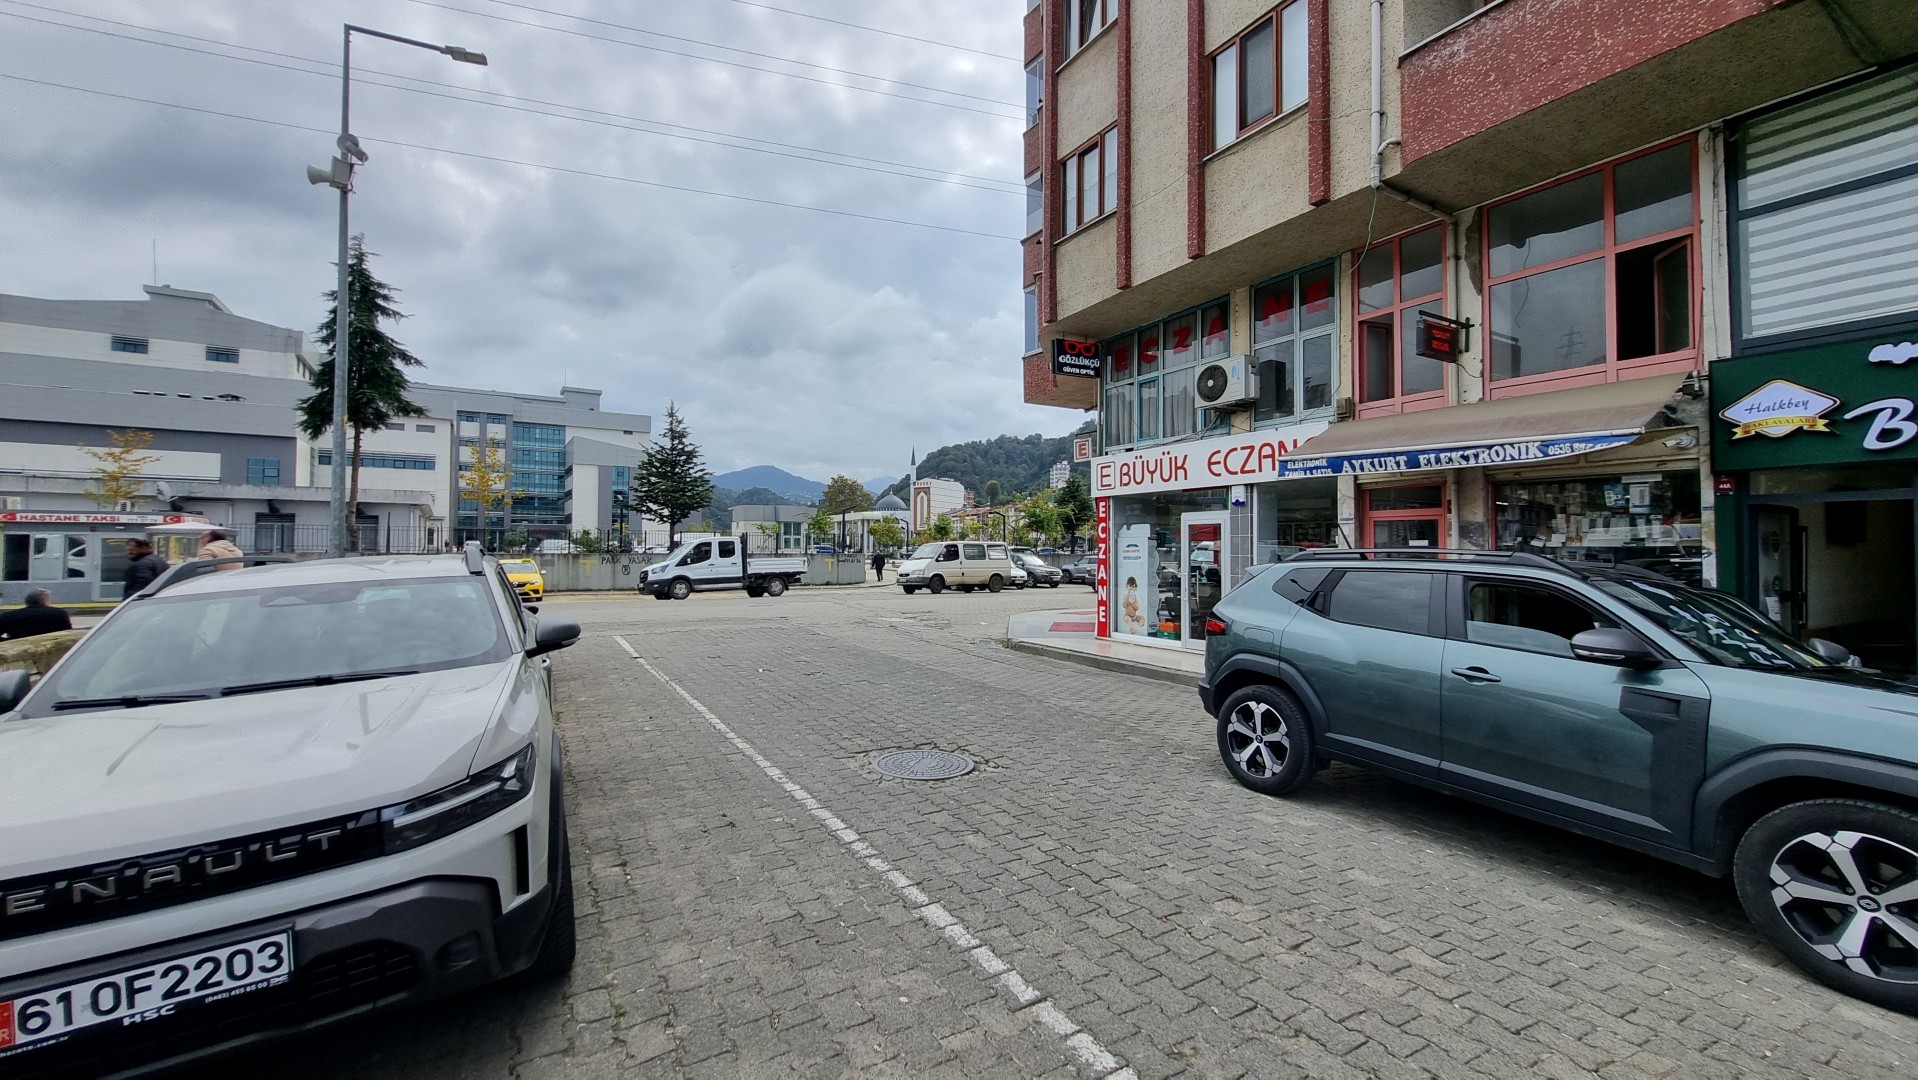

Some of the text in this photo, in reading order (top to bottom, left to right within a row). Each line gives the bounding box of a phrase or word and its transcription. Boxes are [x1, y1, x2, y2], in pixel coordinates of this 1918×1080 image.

[1059, 354, 1100, 368] GÖZLÜKÇÜ
[1062, 365, 1080, 374] GÜVEN
[1744, 398, 1810, 414] Halkbey
[1078, 442, 1088, 457] E
[1119, 450, 1189, 488] BÜYÜK
[1207, 436, 1315, 477] ECZAN
[1341, 455, 1408, 474] AYKURT
[1418, 441, 1544, 469] ELEKTRONIK
[1548, 443, 1571, 456] 0536
[19, 514, 81, 522] HASTANE
[628, 556, 653, 565] YASAK
[1098, 501, 1107, 623] ECZANE
[123, 1004, 176, 1027] HSC
